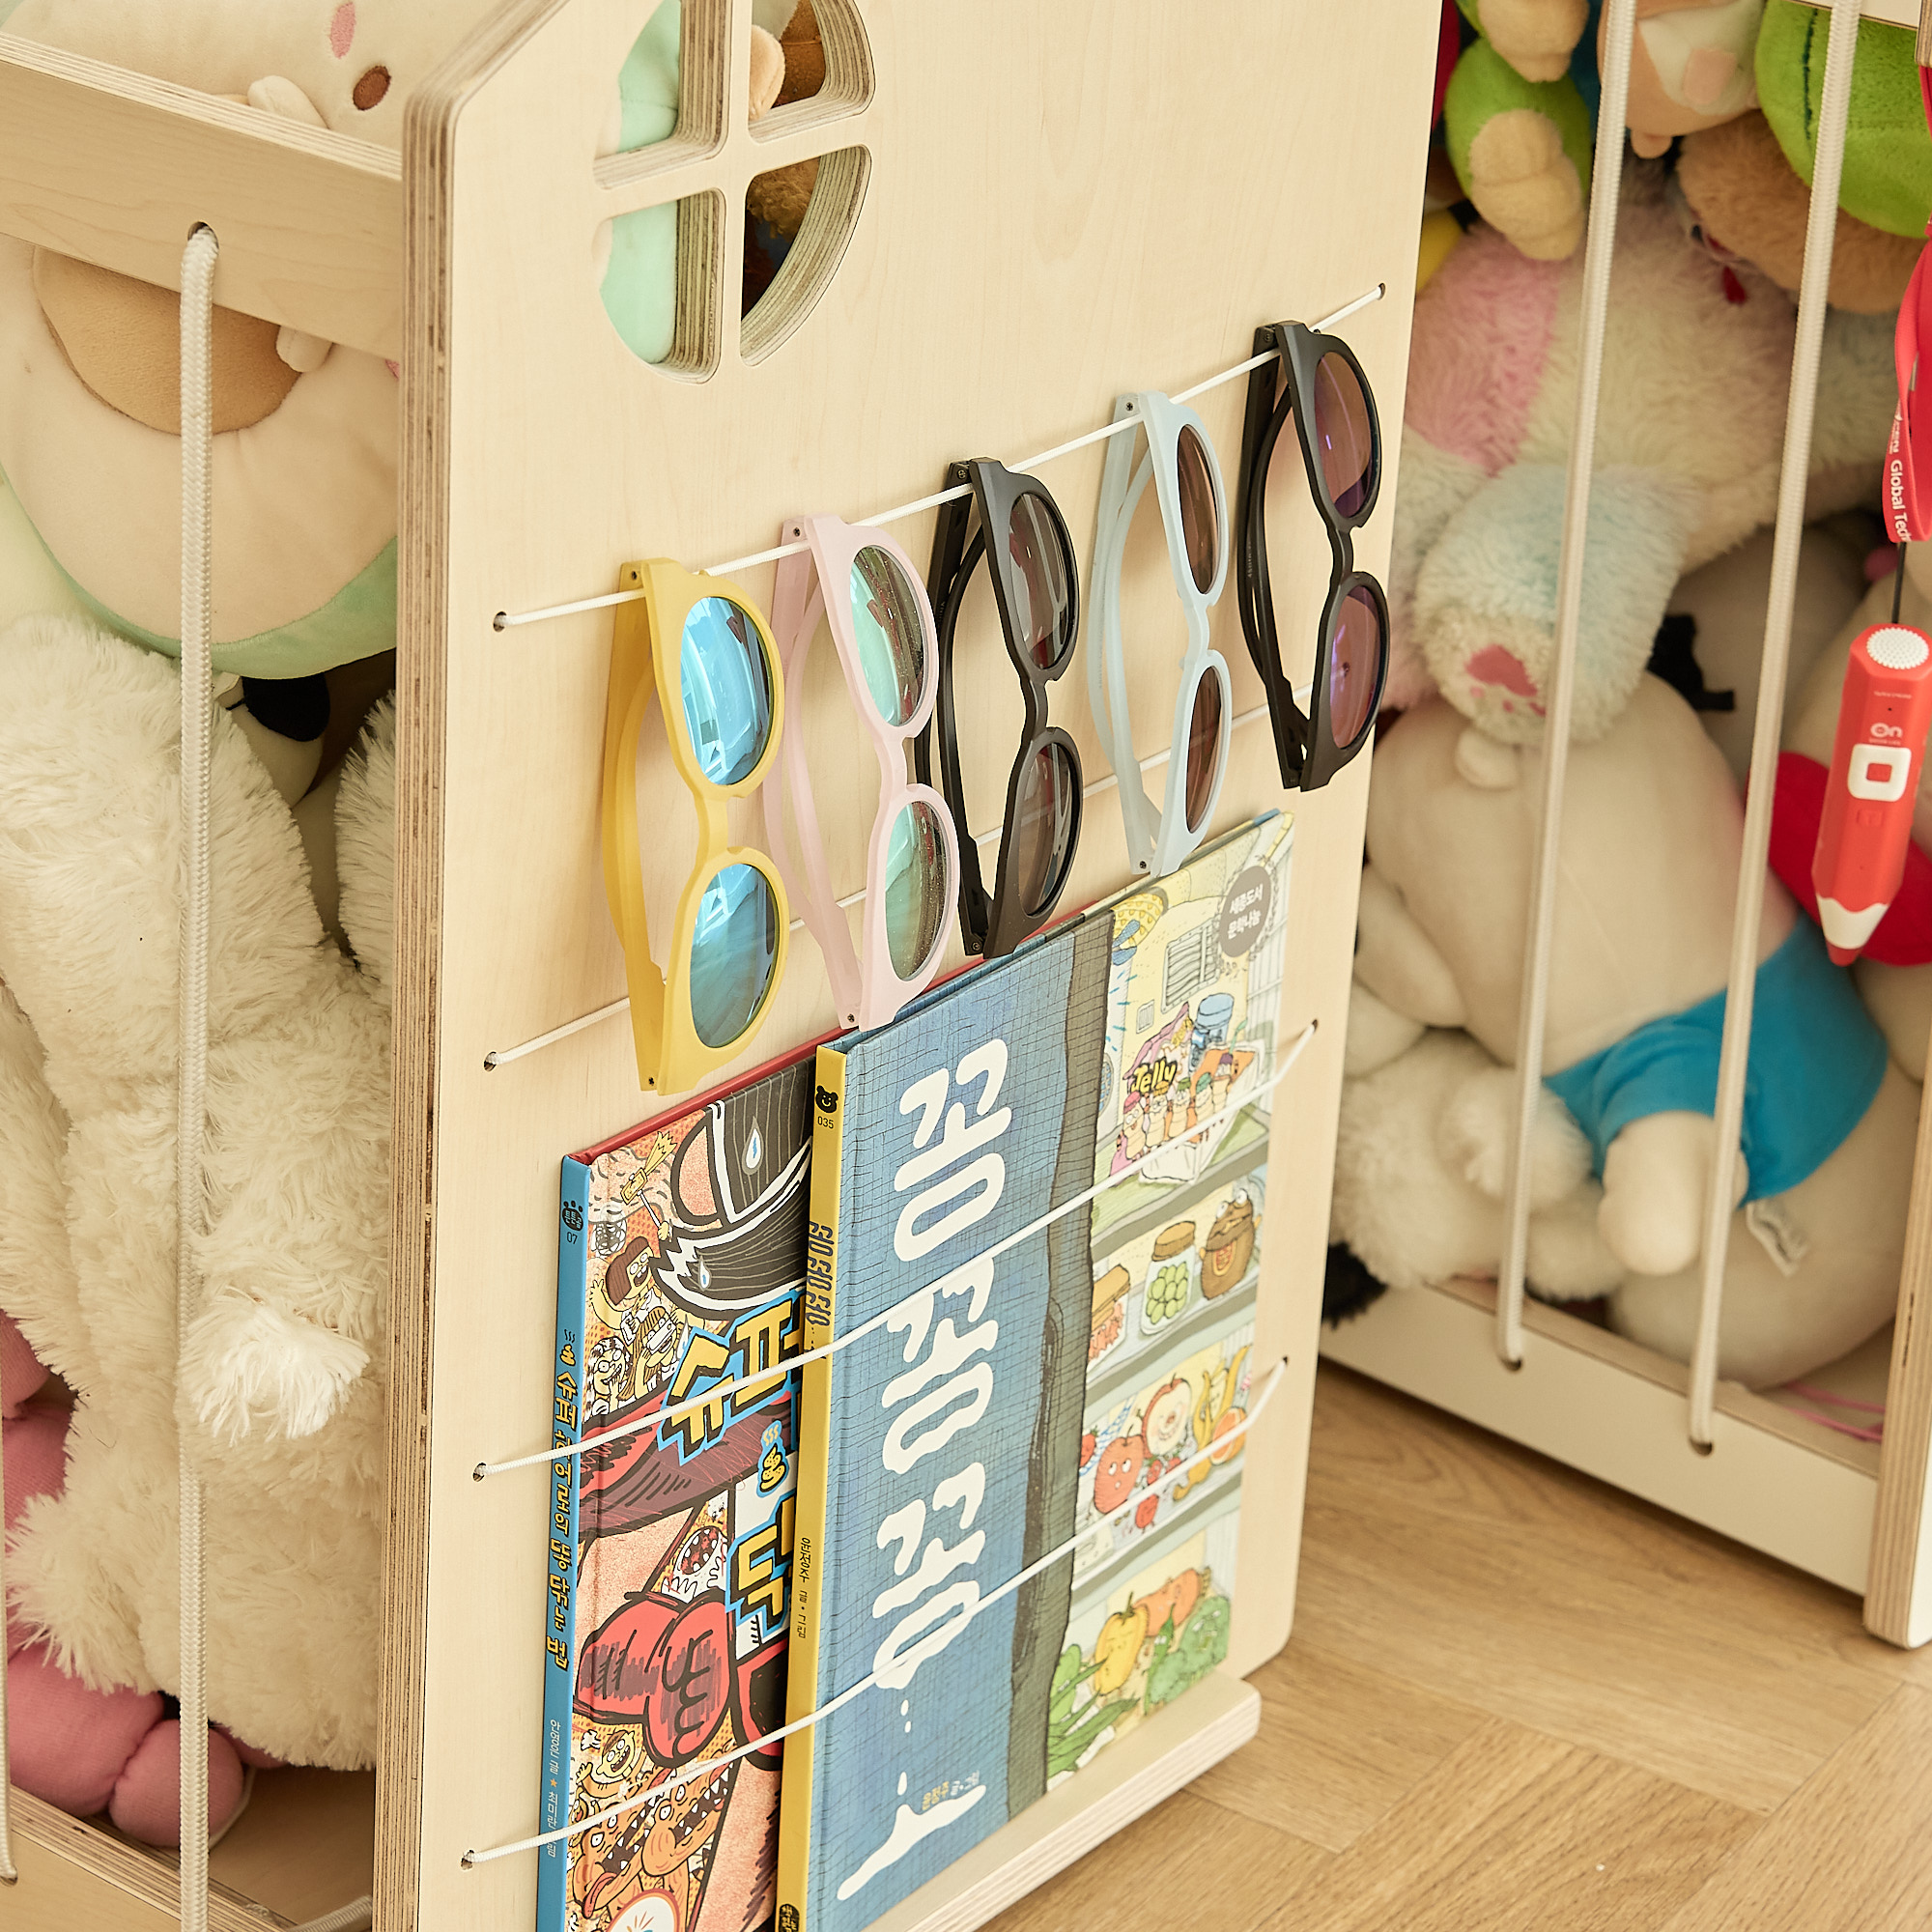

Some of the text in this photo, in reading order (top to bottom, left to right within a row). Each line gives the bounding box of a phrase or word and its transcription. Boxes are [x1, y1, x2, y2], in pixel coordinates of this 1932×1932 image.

[1889, 459, 1906, 511] Global
[1229, 882, 1264, 915] 세종도서
[1227, 909, 1262, 940] 문학나눔
[1129, 1056, 1178, 1094] Jelly
[817, 1116, 835, 1129] 035
[566, 1231, 579, 1245] 07
[554, 1370, 578, 1433] 슈퍼
[550, 1538, 573, 1573] 똥
[798, 1537, 811, 1583] 윤정주
[549, 1573, 570, 1633] 닦는
[546, 1634, 569, 1672] 법
[548, 1759, 559, 1776] 글
